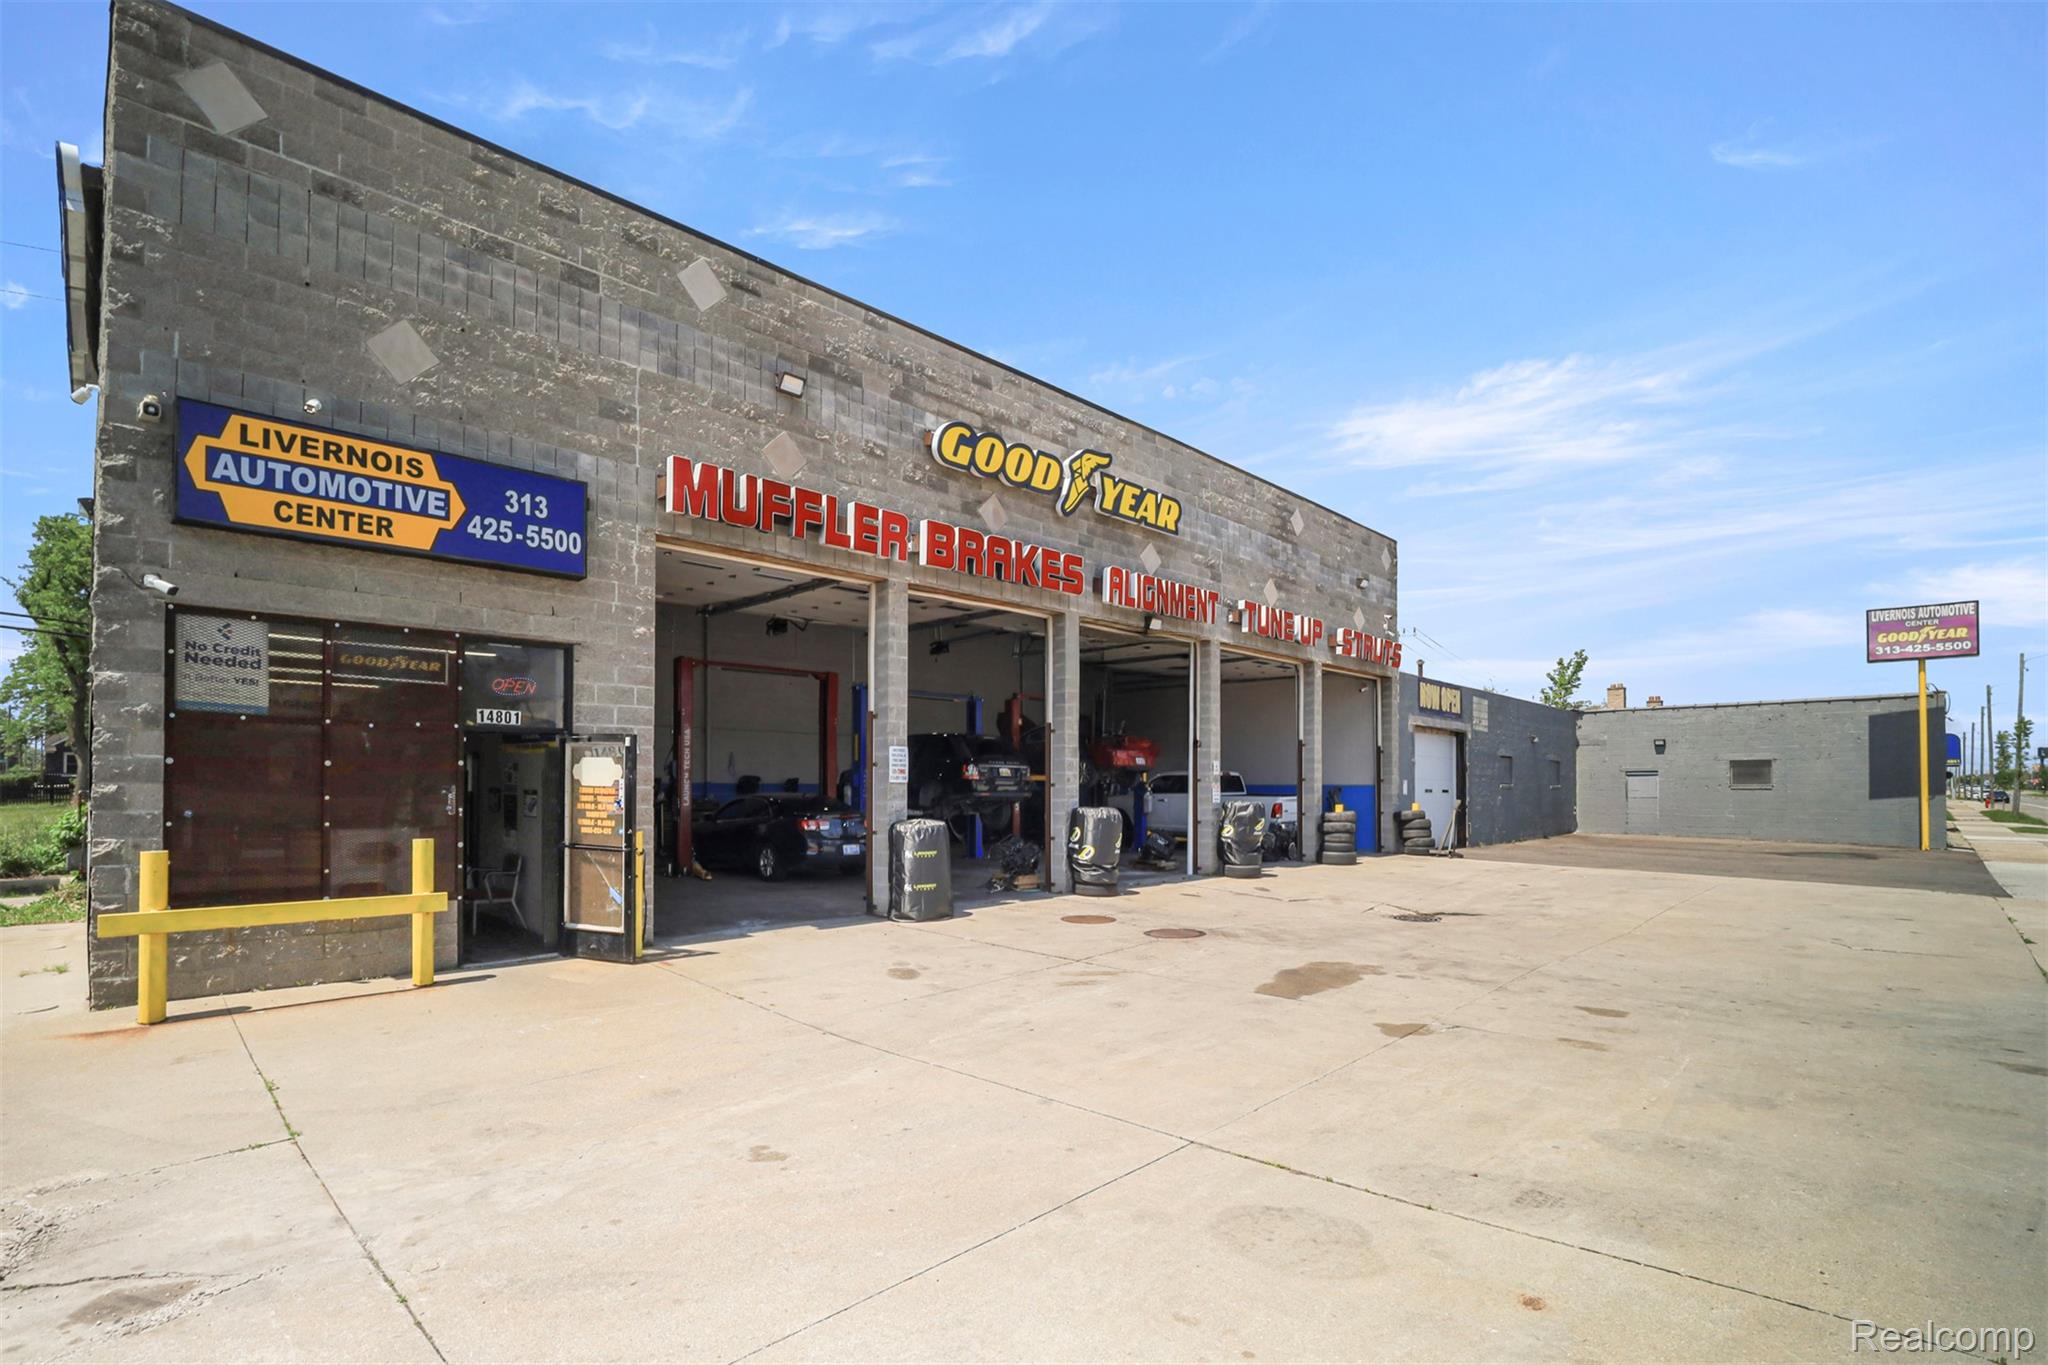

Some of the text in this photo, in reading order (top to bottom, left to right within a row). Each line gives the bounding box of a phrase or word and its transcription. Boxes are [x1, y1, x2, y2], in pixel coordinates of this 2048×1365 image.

[240, 423, 424, 479] LIVERNOIS
[211, 452, 447, 517] AUTOMOTIVE
[273, 500, 394, 538] CENTER
[504, 490, 549, 519] 313
[667, 454, 909, 561] MUFFLER
[466, 515, 582, 555] 425-5500
[920, 519, 1085, 596] BRAKES
[1103, 565, 1220, 625] ALIGNMENT
[1871, 602, 1975, 622] LIVERNOIS AUTOMOTIVE
[1239, 600, 1324, 648] TUNE UP
[1905, 619, 1940, 627] CENTER
[184, 652, 262, 670] Needed
[185, 641, 261, 657] No Credit
[1337, 627, 1402, 669] STRUTS
[1875, 641, 1972, 655] 313-425-5500
[491, 677, 537, 695] OPEN
[478, 710, 521, 725] 14801
